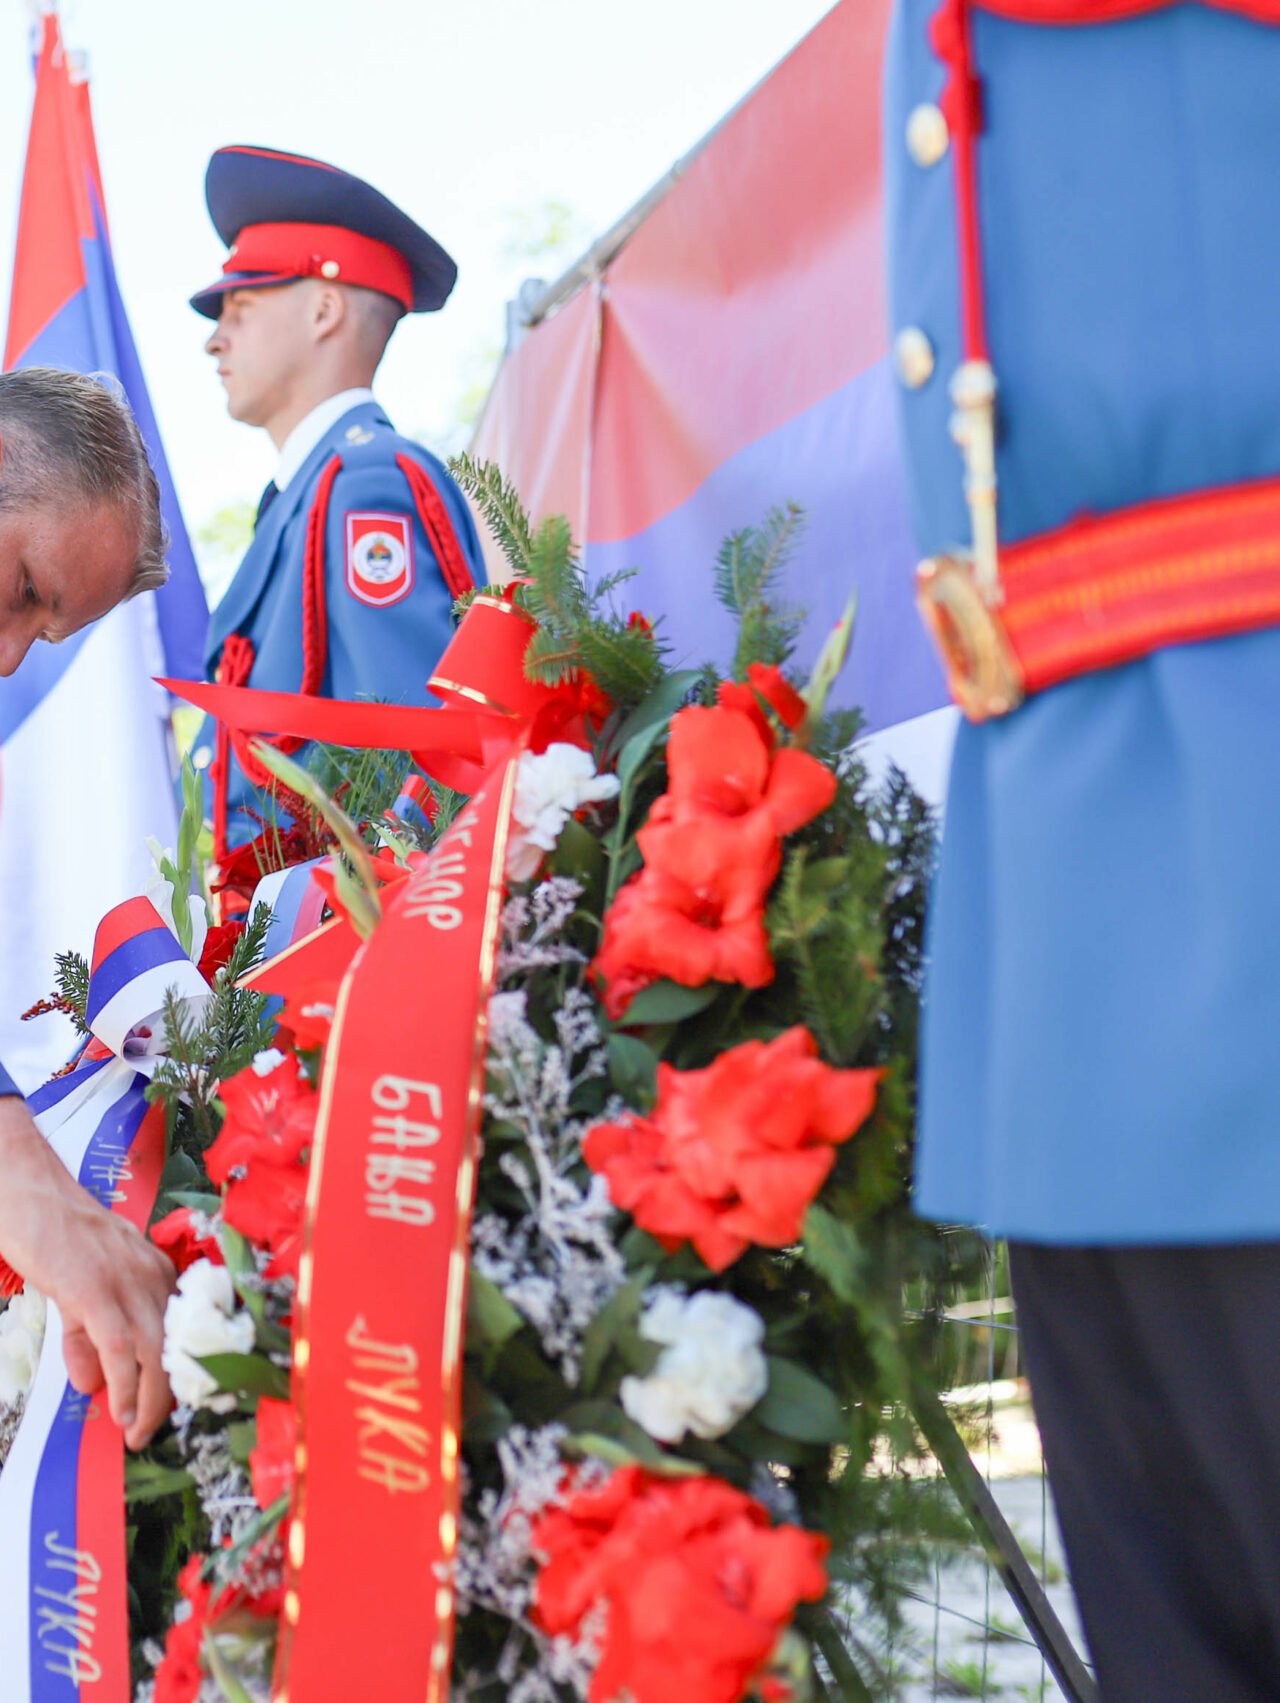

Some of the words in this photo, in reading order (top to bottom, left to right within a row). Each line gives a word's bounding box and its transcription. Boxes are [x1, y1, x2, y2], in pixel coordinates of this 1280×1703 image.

[365, 1073, 443, 1226] БАЊА
[345, 1314, 431, 1494] ЛУКА
[33, 1531, 102, 1688] ЛУКА
